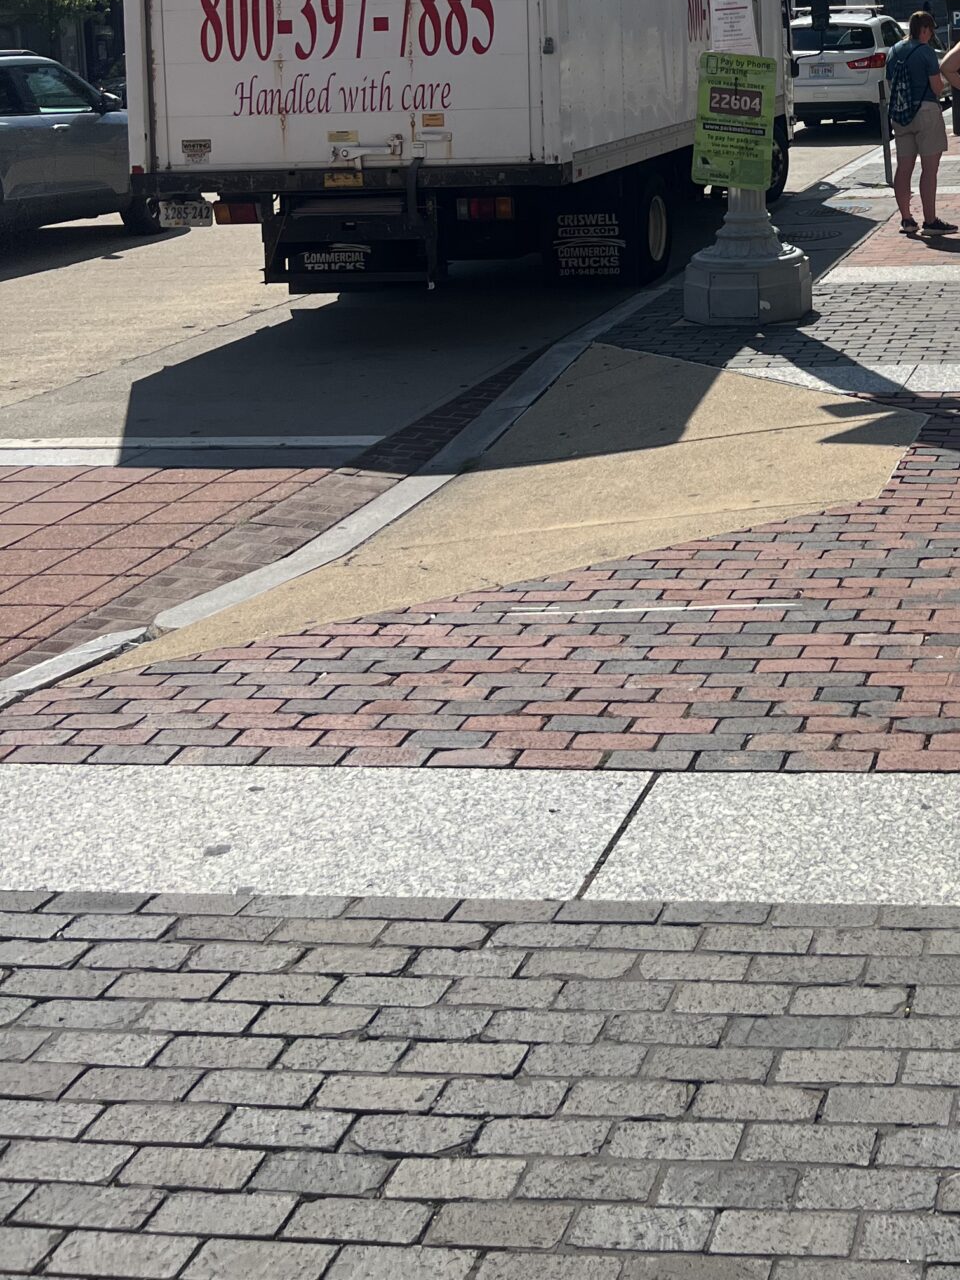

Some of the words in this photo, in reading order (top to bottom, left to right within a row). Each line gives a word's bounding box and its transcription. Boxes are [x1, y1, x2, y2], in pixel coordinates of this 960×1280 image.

[720, 57, 733, 67] Pay
[735, 58, 745, 68] by
[746, 59, 771, 70] Phone
[720, 66, 748, 78] Parking
[233, 72, 337, 116] Handled
[338, 71, 394, 113] with
[401, 81, 453, 111] care
[710, 93, 761, 112] 22604
[715, 134, 726, 142] pay
[557, 213, 619, 226] CRISWELL
[559, 227, 617, 236] AUTO.COM
[558, 246, 620, 257] COMMERCIAL
[304, 252, 366, 263] COMMERCIAL
[558, 257, 620, 267] TRUCKS
[304, 262, 366, 270] TRUCKS
